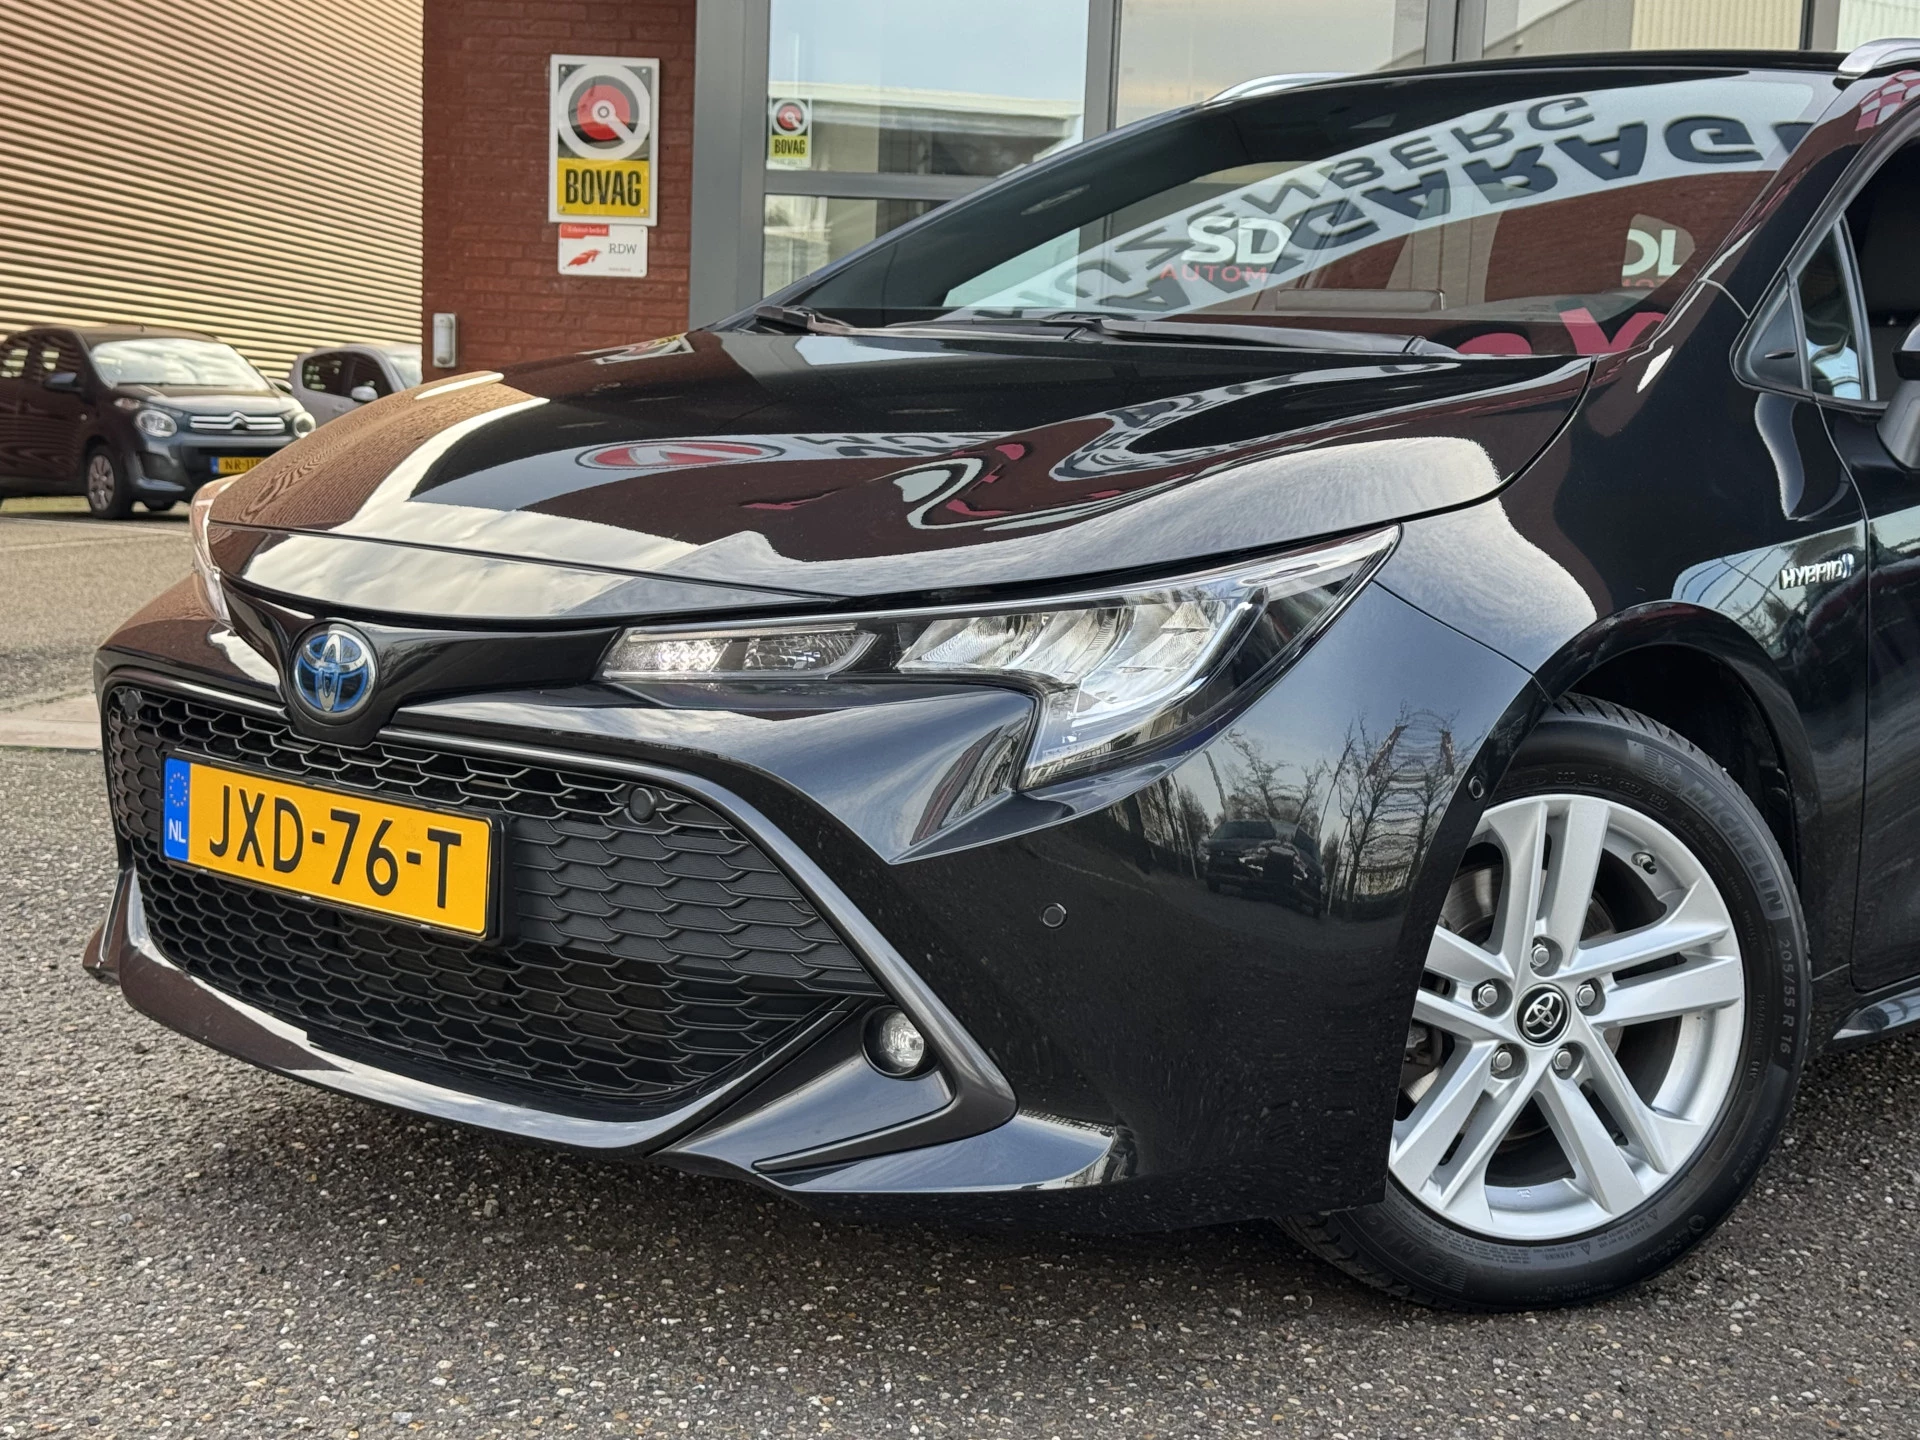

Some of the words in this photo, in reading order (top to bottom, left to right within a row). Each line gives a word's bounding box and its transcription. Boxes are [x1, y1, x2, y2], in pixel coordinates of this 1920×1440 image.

[774, 138, 805, 154] BOVAG
[565, 168, 641, 206] BOVAG
[608, 243, 637, 254] RDW
[1779, 560, 1844, 590] HYBRID
[168, 819, 187, 844] NL
[209, 785, 462, 909] JXD-76-T
[1680, 781, 1784, 912] MICHELIN
[1780, 938, 1796, 1008] 205/55
[1782, 1014, 1795, 1028] R
[1780, 1034, 1792, 1054] 16
